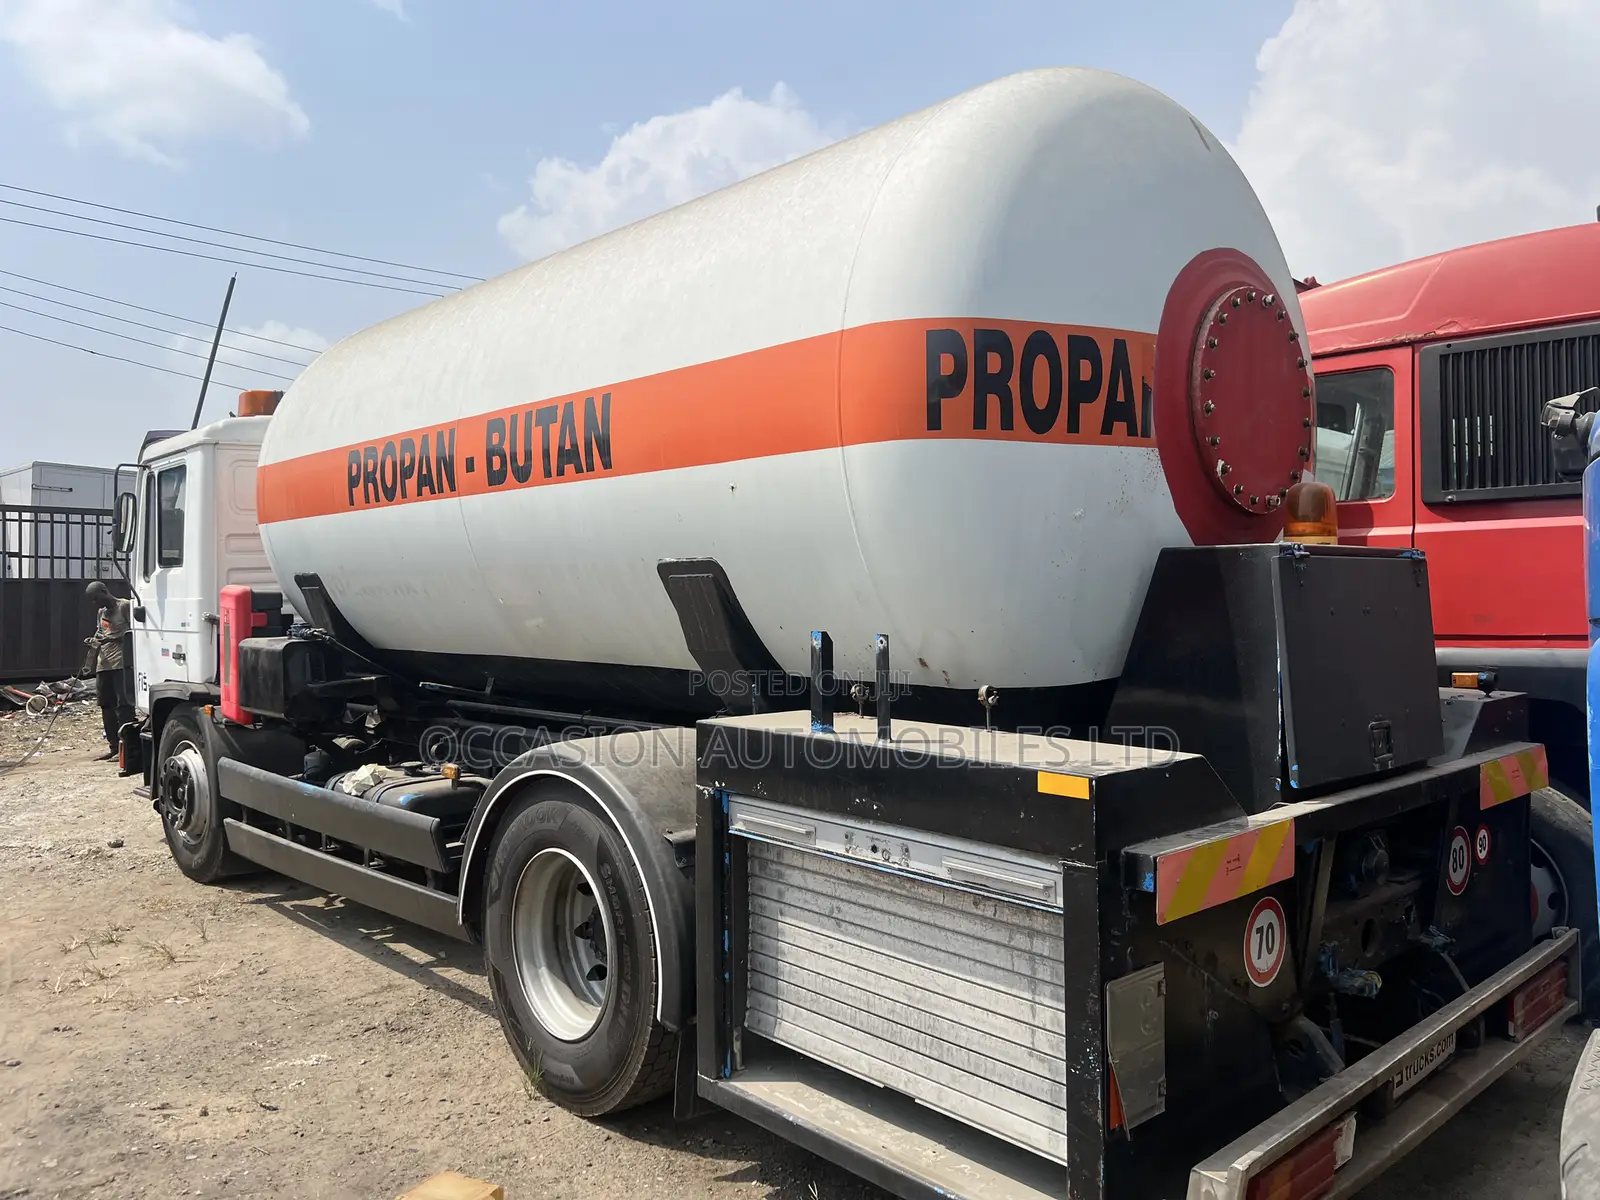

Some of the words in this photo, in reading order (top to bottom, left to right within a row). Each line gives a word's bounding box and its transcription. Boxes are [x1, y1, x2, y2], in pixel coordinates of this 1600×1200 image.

[347, 427, 457, 507] PROPAN
[485, 391, 613, 487] BUTAN
[1451, 844, 1465, 874] 80
[1478, 834, 1487, 854] 90
[1255, 921, 1276, 961] 70
[1404, 1032, 1455, 1081] trucks.com
